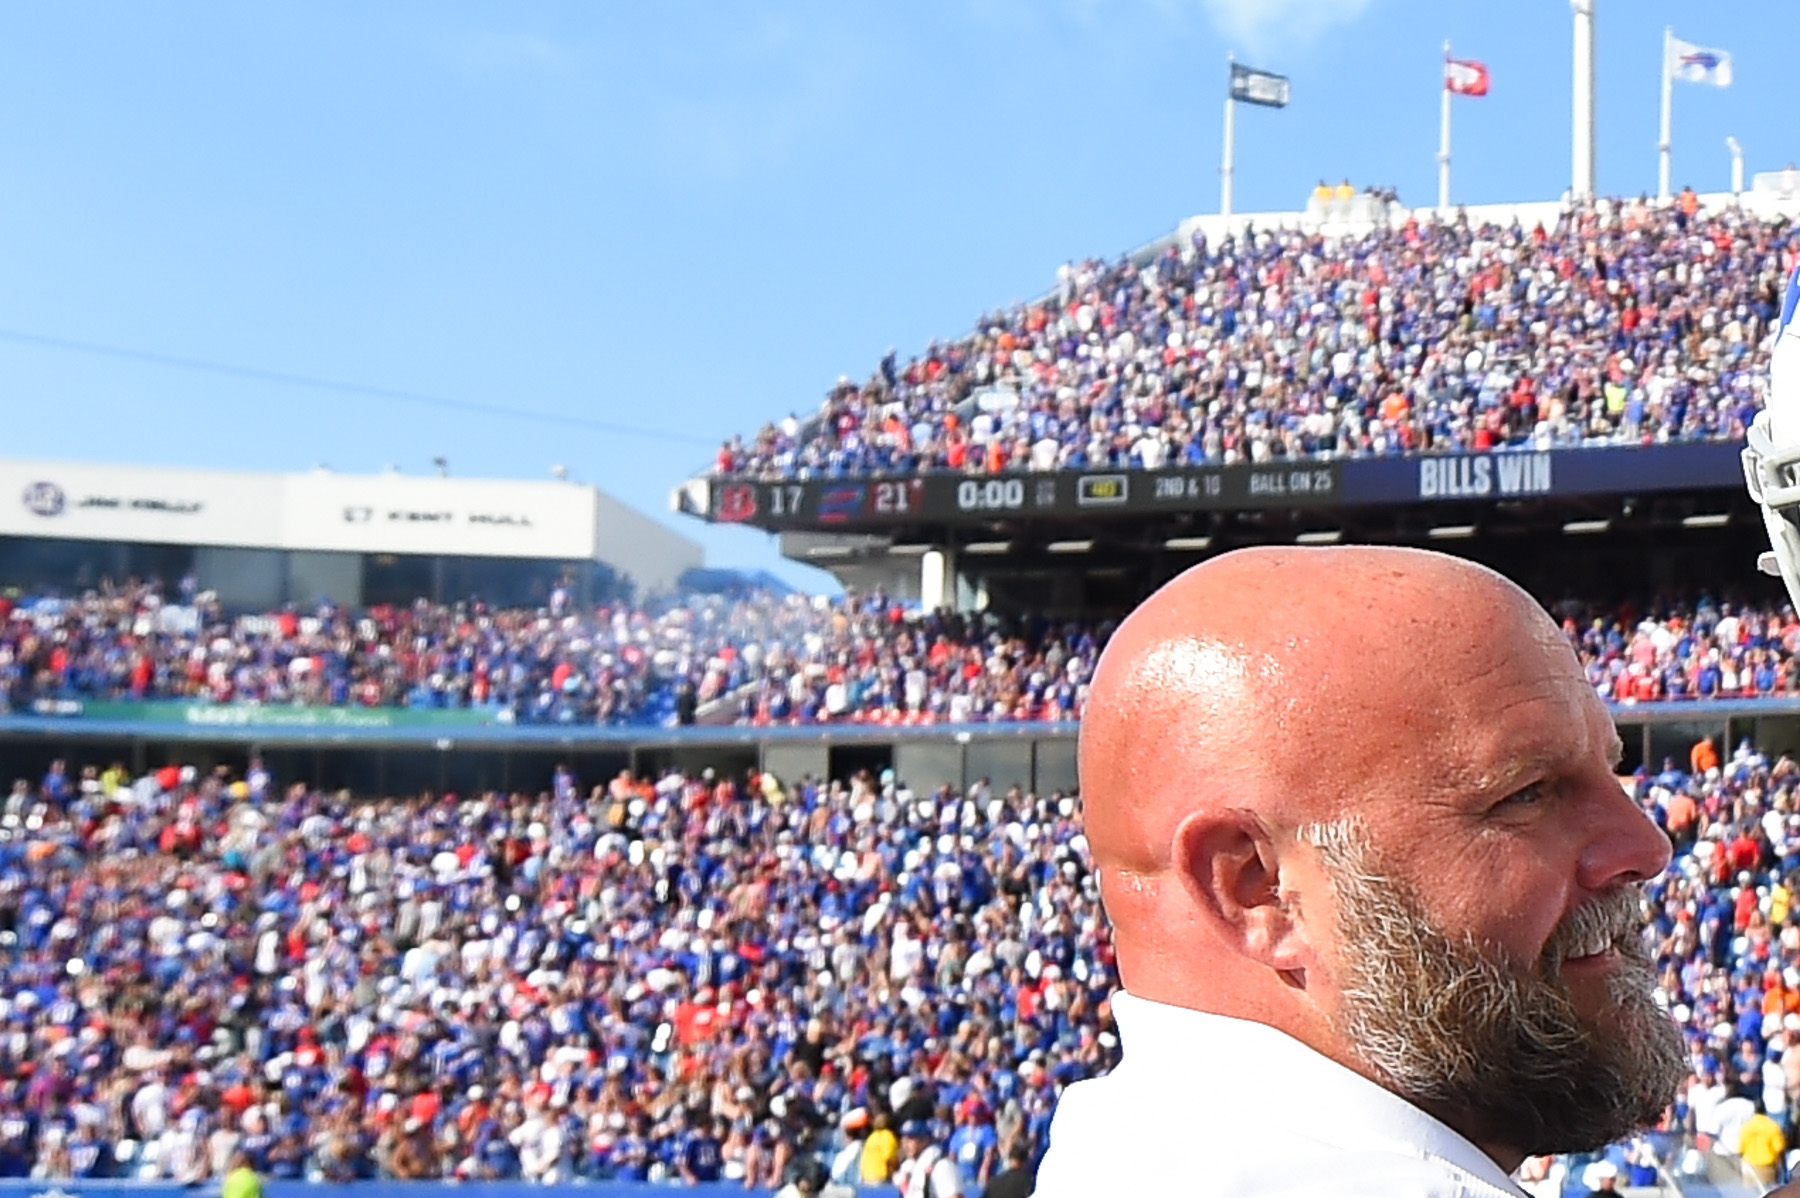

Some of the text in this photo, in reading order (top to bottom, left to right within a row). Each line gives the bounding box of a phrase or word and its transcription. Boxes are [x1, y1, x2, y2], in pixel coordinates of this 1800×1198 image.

[1155, 476, 1184, 496] 2ND
[1205, 474, 1221, 496] 10
[1250, 473, 1285, 495] BALL
[1313, 470, 1332, 490] 25
[1420, 453, 1551, 496] BILLS WIN
[771, 485, 803, 515] 17
[876, 482, 908, 512] 21
[957, 479, 1024, 509] 0:00
